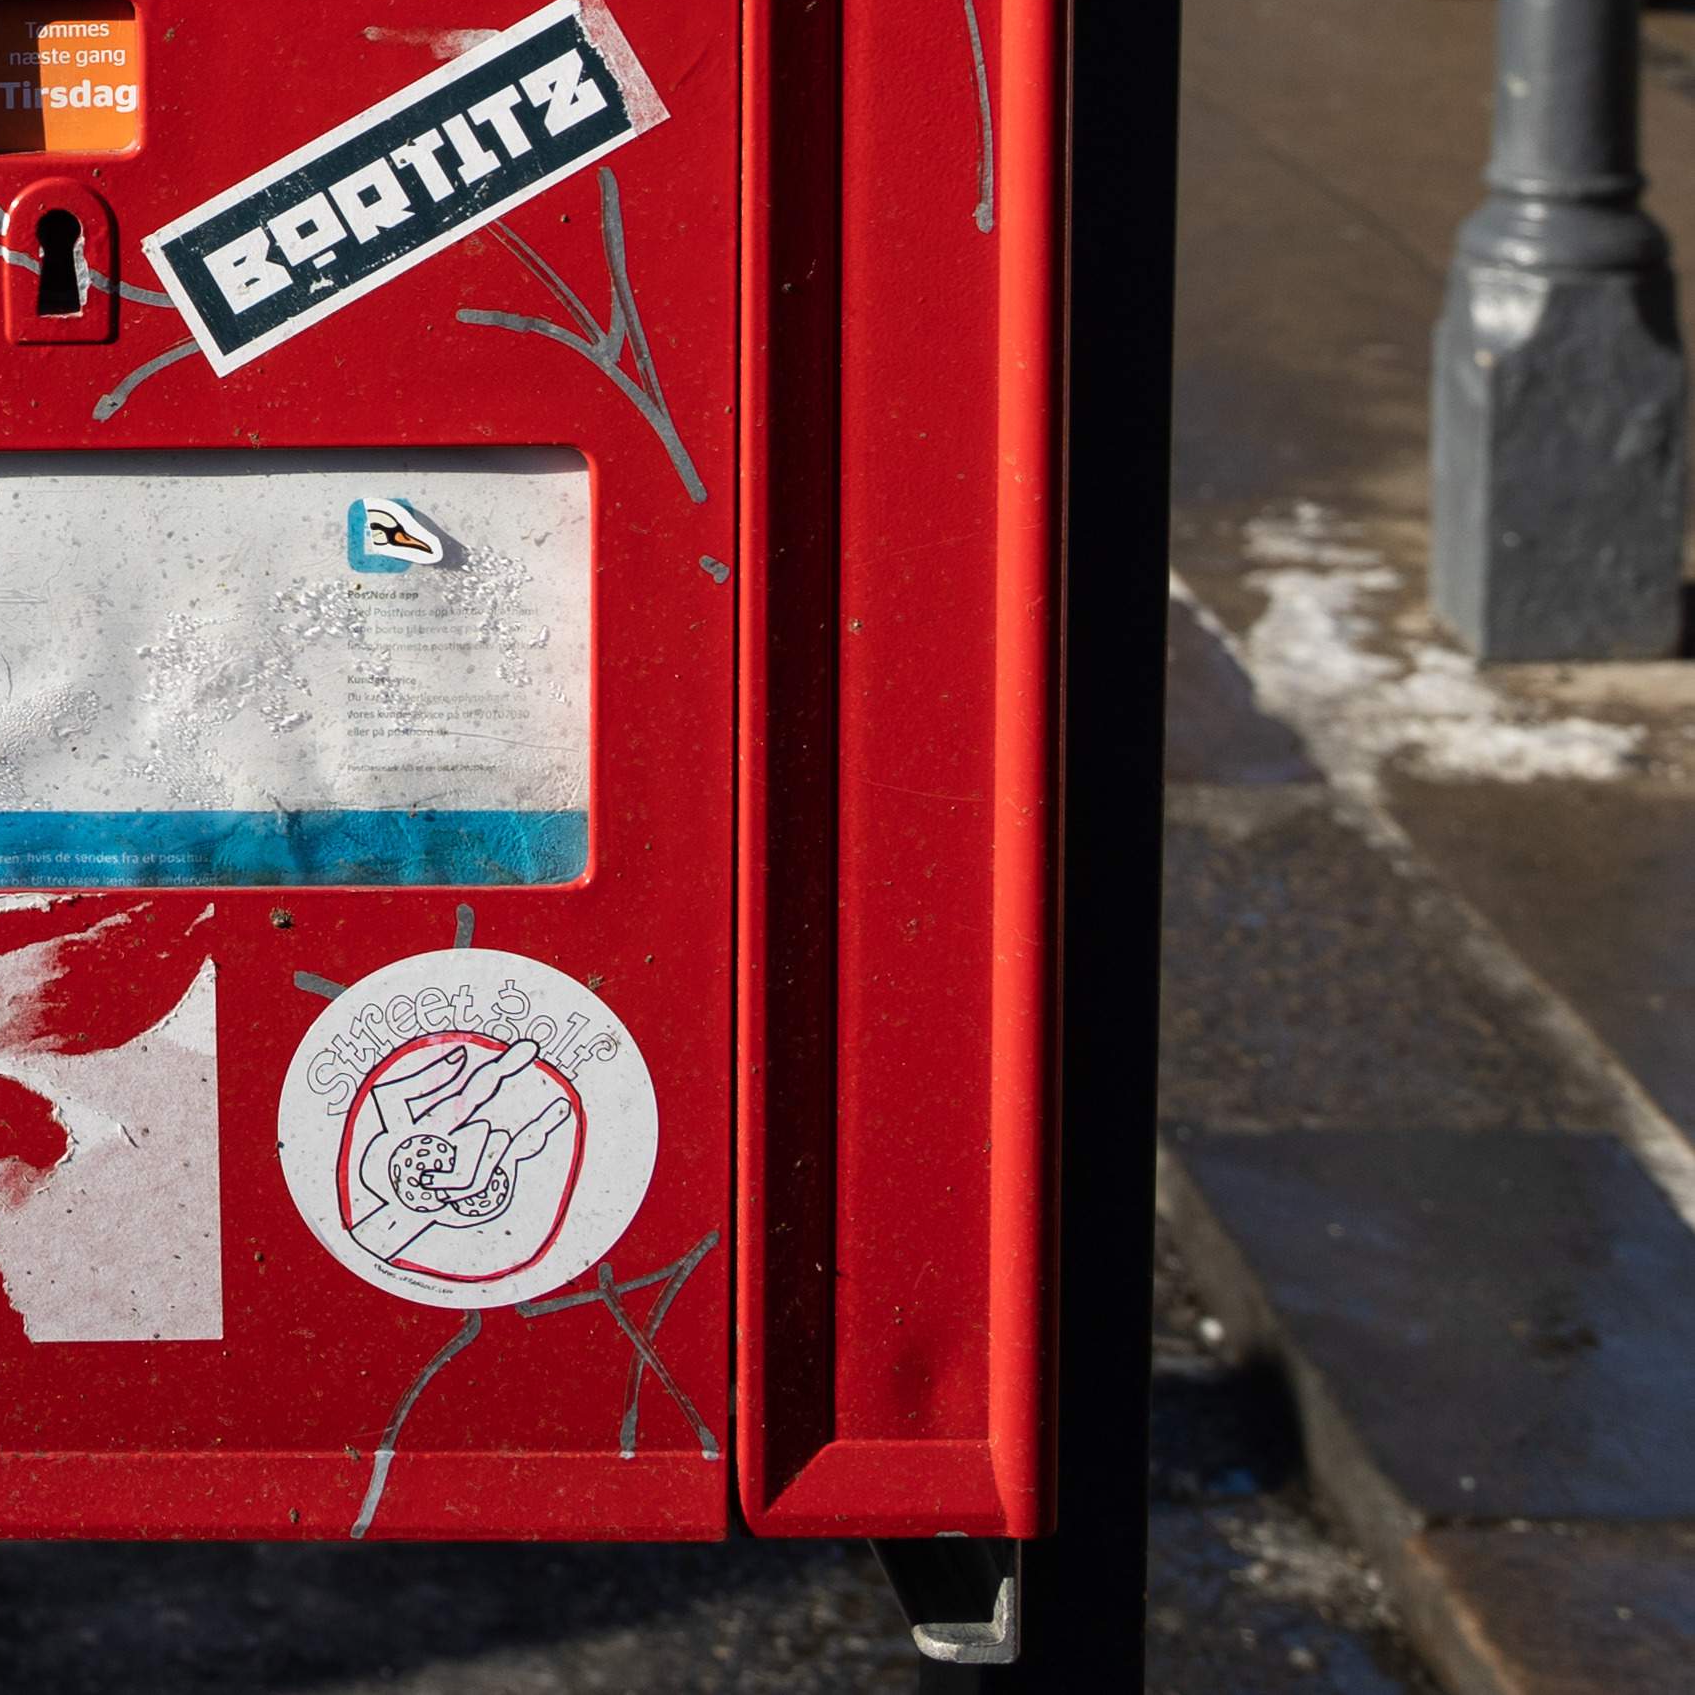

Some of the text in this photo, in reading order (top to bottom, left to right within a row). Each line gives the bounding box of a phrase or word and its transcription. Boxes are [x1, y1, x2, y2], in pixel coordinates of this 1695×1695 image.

[24, 21, 110, 38] Tømmes
[9, 48, 126, 67] næste gang
[399, 592, 419, 601] app
[27, 852, 51, 864] hvis
[54, 853, 71, 864] de
[74, 852, 119, 864] sendes
[122, 853, 140, 865] fra
[142, 853, 157, 864] et
[307, 978, 618, 1116] Street golf
